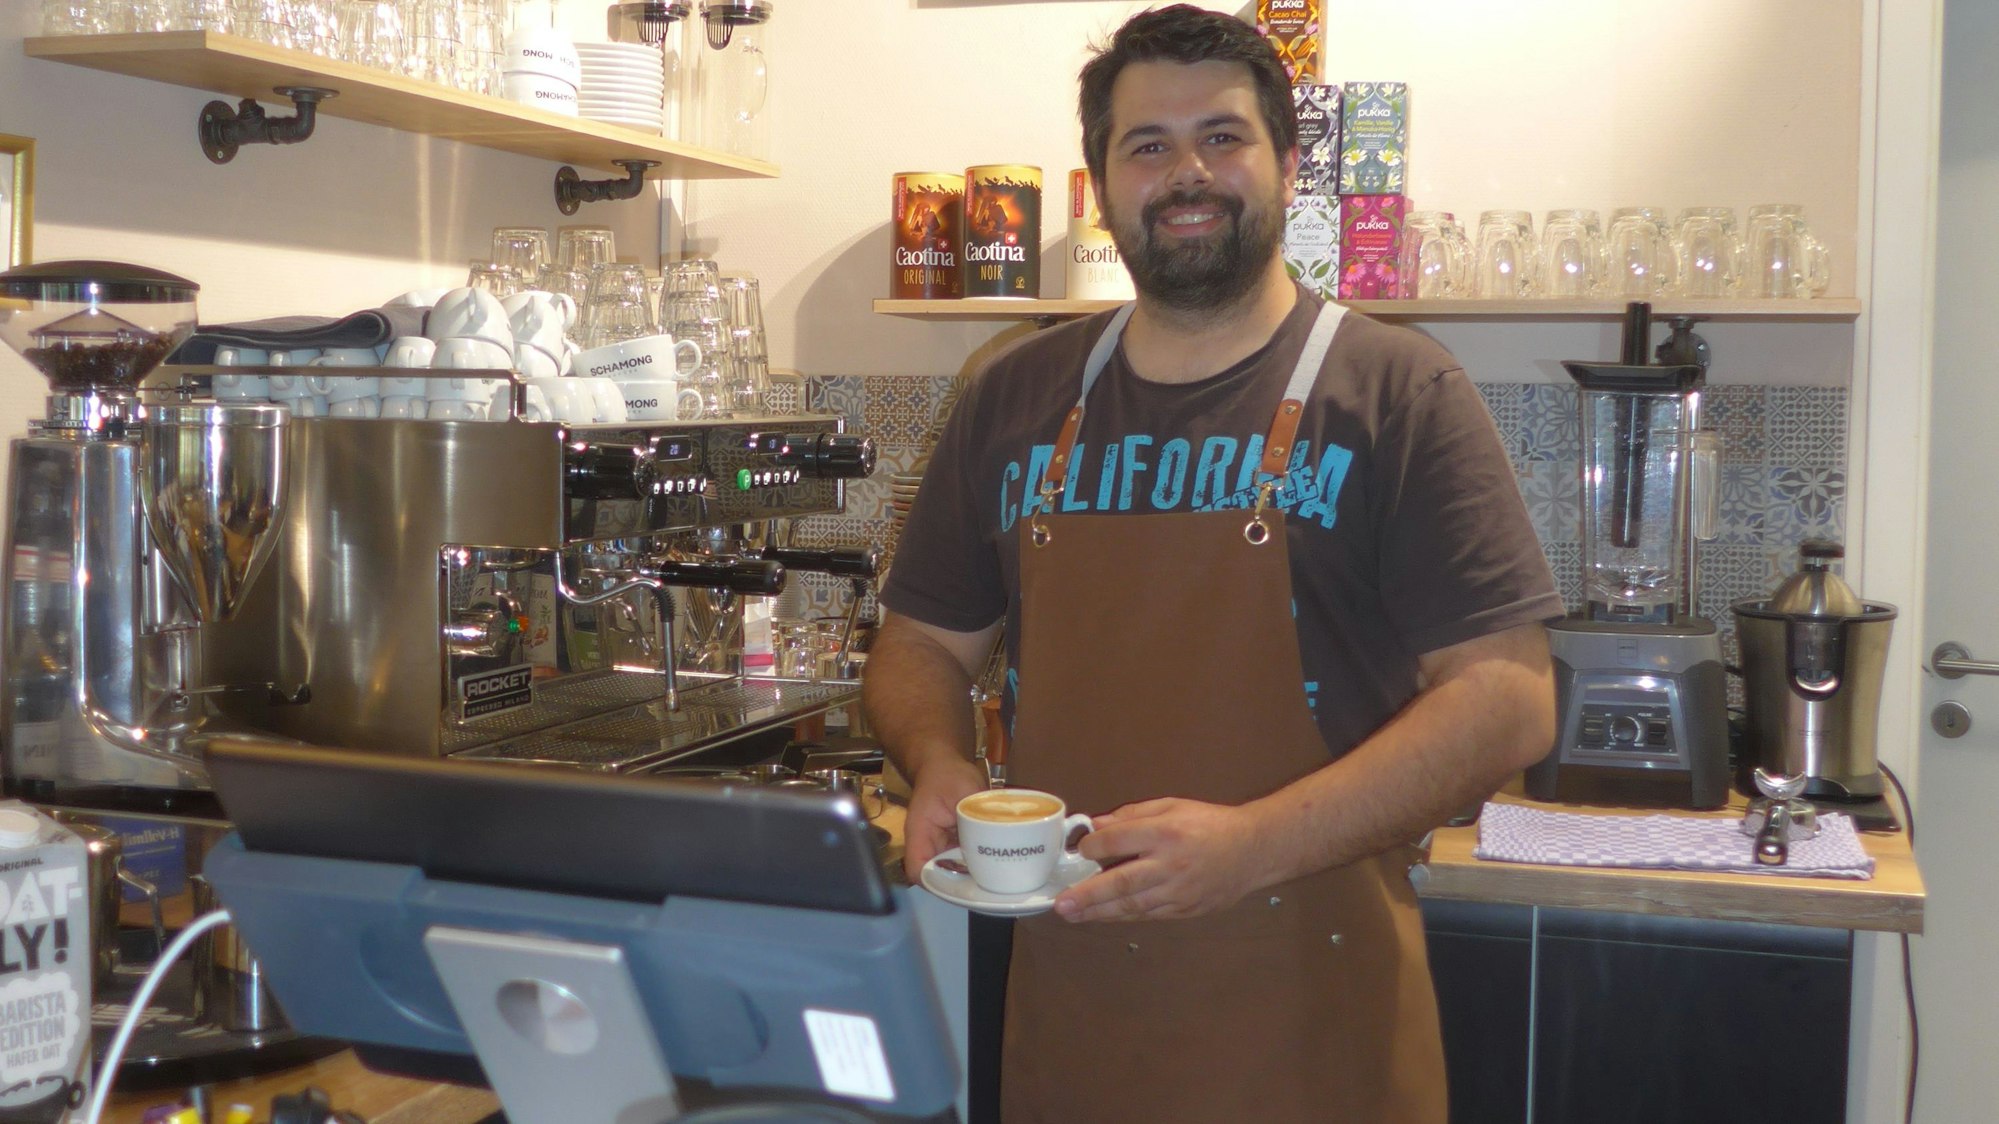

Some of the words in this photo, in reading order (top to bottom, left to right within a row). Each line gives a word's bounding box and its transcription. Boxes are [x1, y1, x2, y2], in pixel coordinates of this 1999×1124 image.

[1297, 107, 1323, 120] ukka
[1357, 107, 1391, 119] pukka
[1293, 222, 1325, 233] pukka
[1355, 220, 1389, 231] pukka
[1297, 232, 1320, 241] Peace
[895, 246, 956, 267] Caotina
[964, 241, 1025, 262] Caotina
[903, 268, 946, 286] ORIGINAL
[980, 264, 1004, 281] NOIR
[590, 354, 653, 377] SCHAMONG
[467, 671, 529, 698] ROCKET
[977, 844, 1045, 857] SCHAMONG
